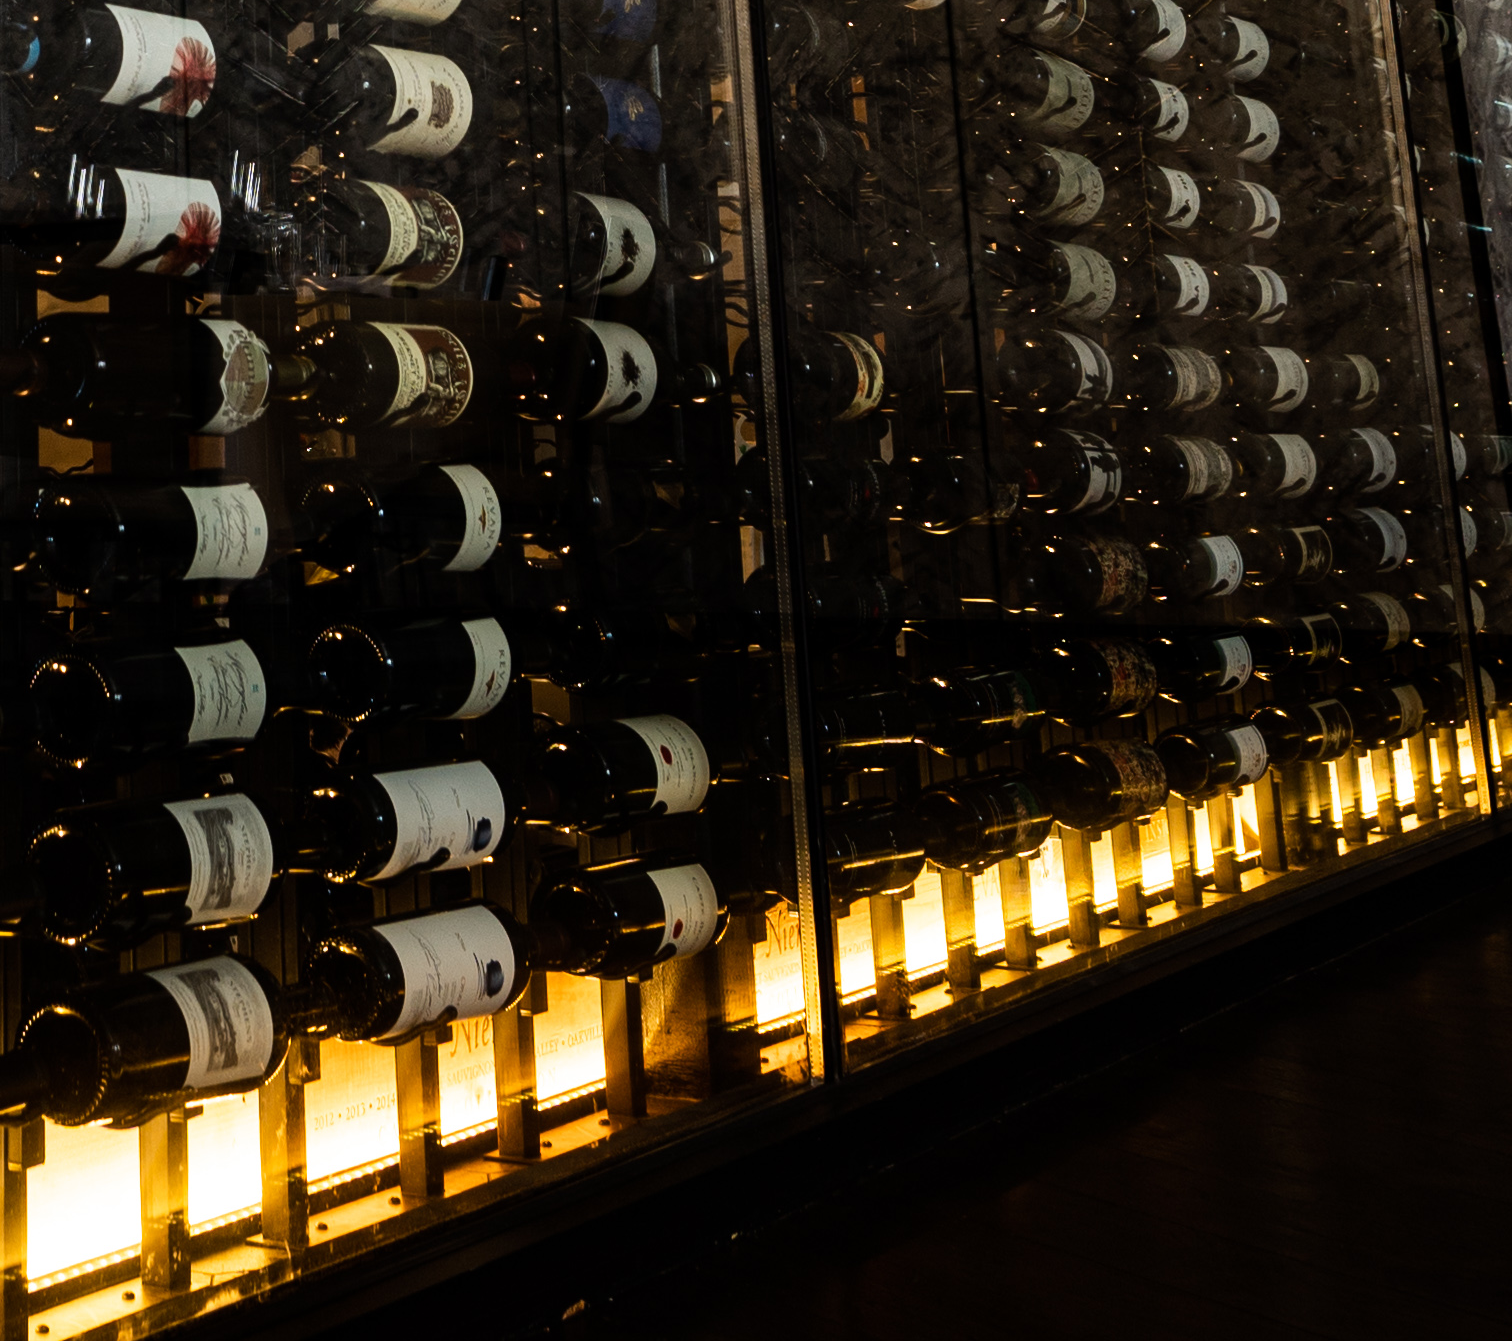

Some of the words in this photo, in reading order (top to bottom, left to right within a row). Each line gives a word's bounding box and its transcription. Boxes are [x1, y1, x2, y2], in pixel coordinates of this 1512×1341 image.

[480, 485, 497, 552] REVANA
[450, 1014, 491, 1057] Nie
[314, 1113, 335, 1131] 2012
[346, 1101, 366, 1120] 2013
[376, 1092, 396, 1110] 2014
